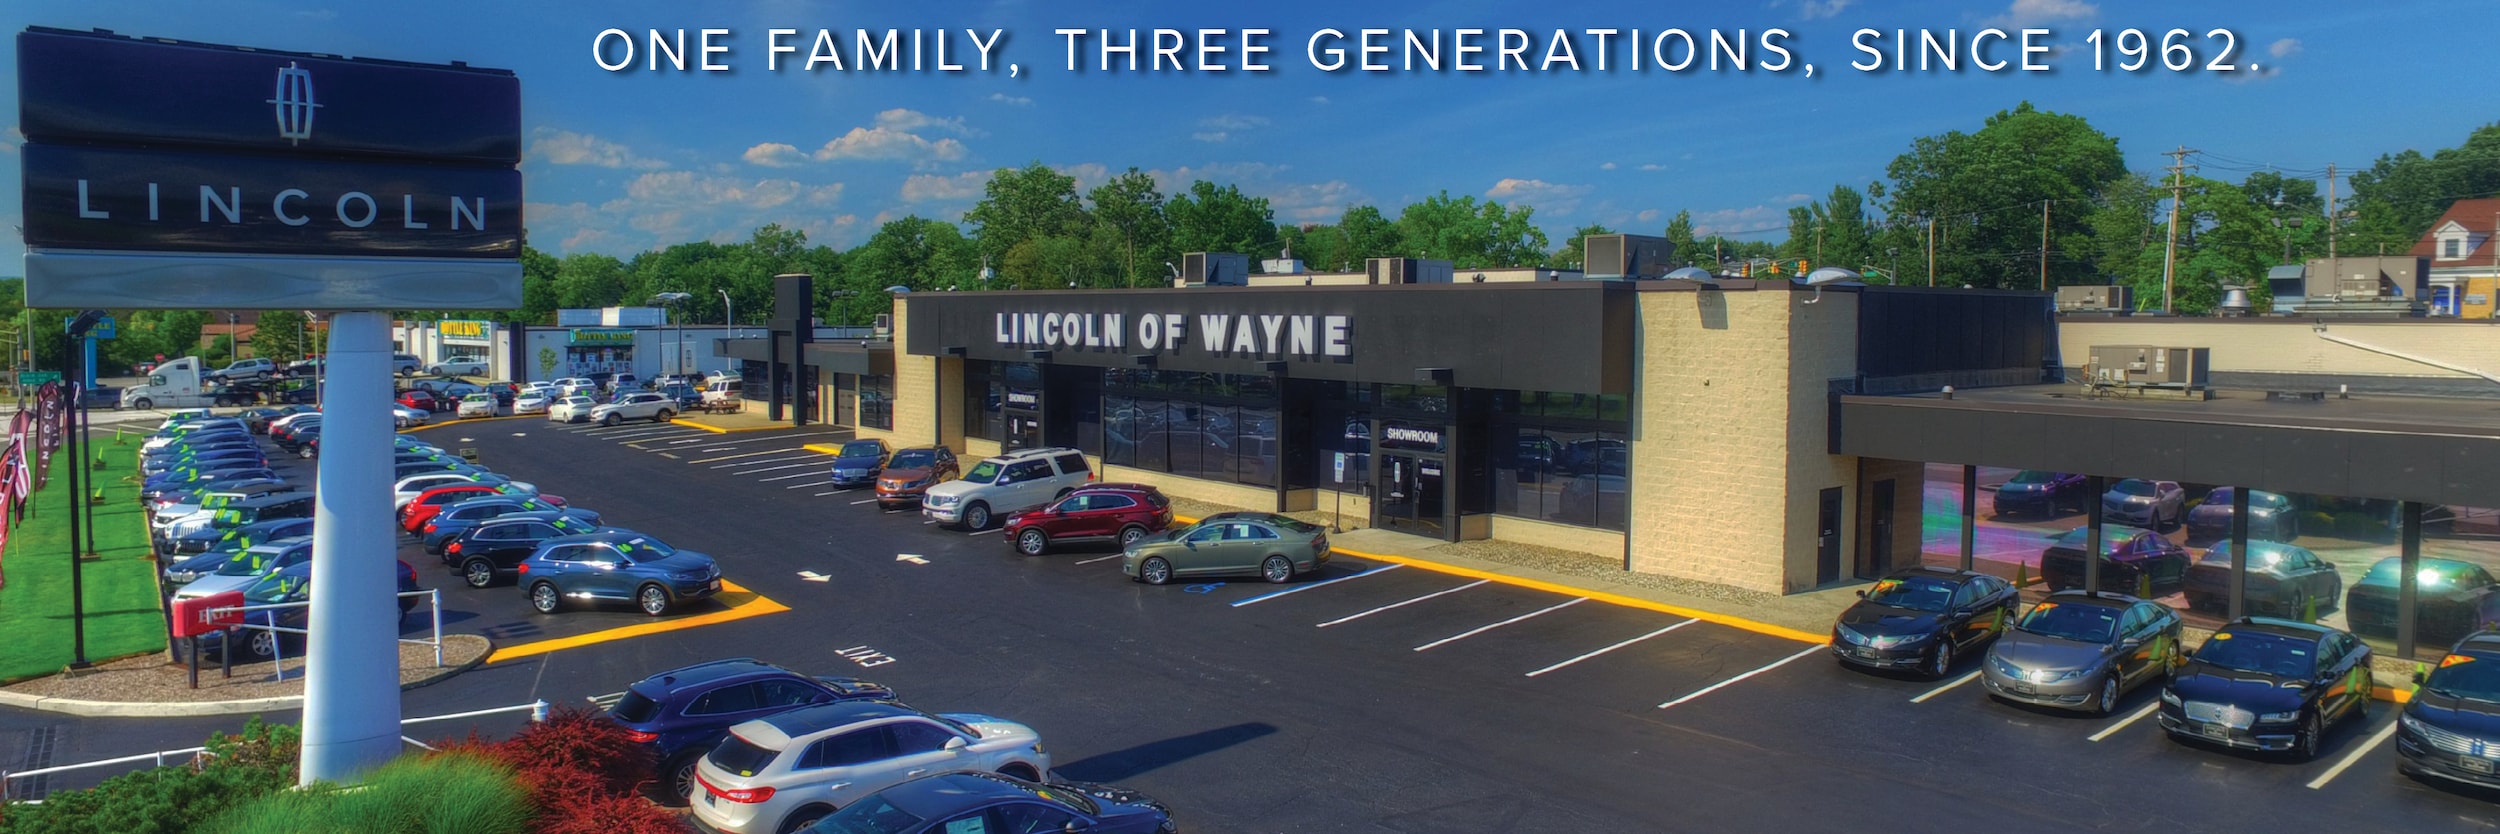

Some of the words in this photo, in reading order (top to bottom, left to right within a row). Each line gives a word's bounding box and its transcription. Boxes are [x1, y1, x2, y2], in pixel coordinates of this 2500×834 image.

[78, 179, 485, 231] LINCOLN
[996, 312, 1122, 347] LINCOLN
[1138, 313, 1184, 350] OF
[1200, 314, 1348, 356] WAYNE
[1008, 393, 1036, 403] SHOWROOM
[1387, 428, 1438, 443] SHOWROOM
[834, 645, 896, 667] EXIT
